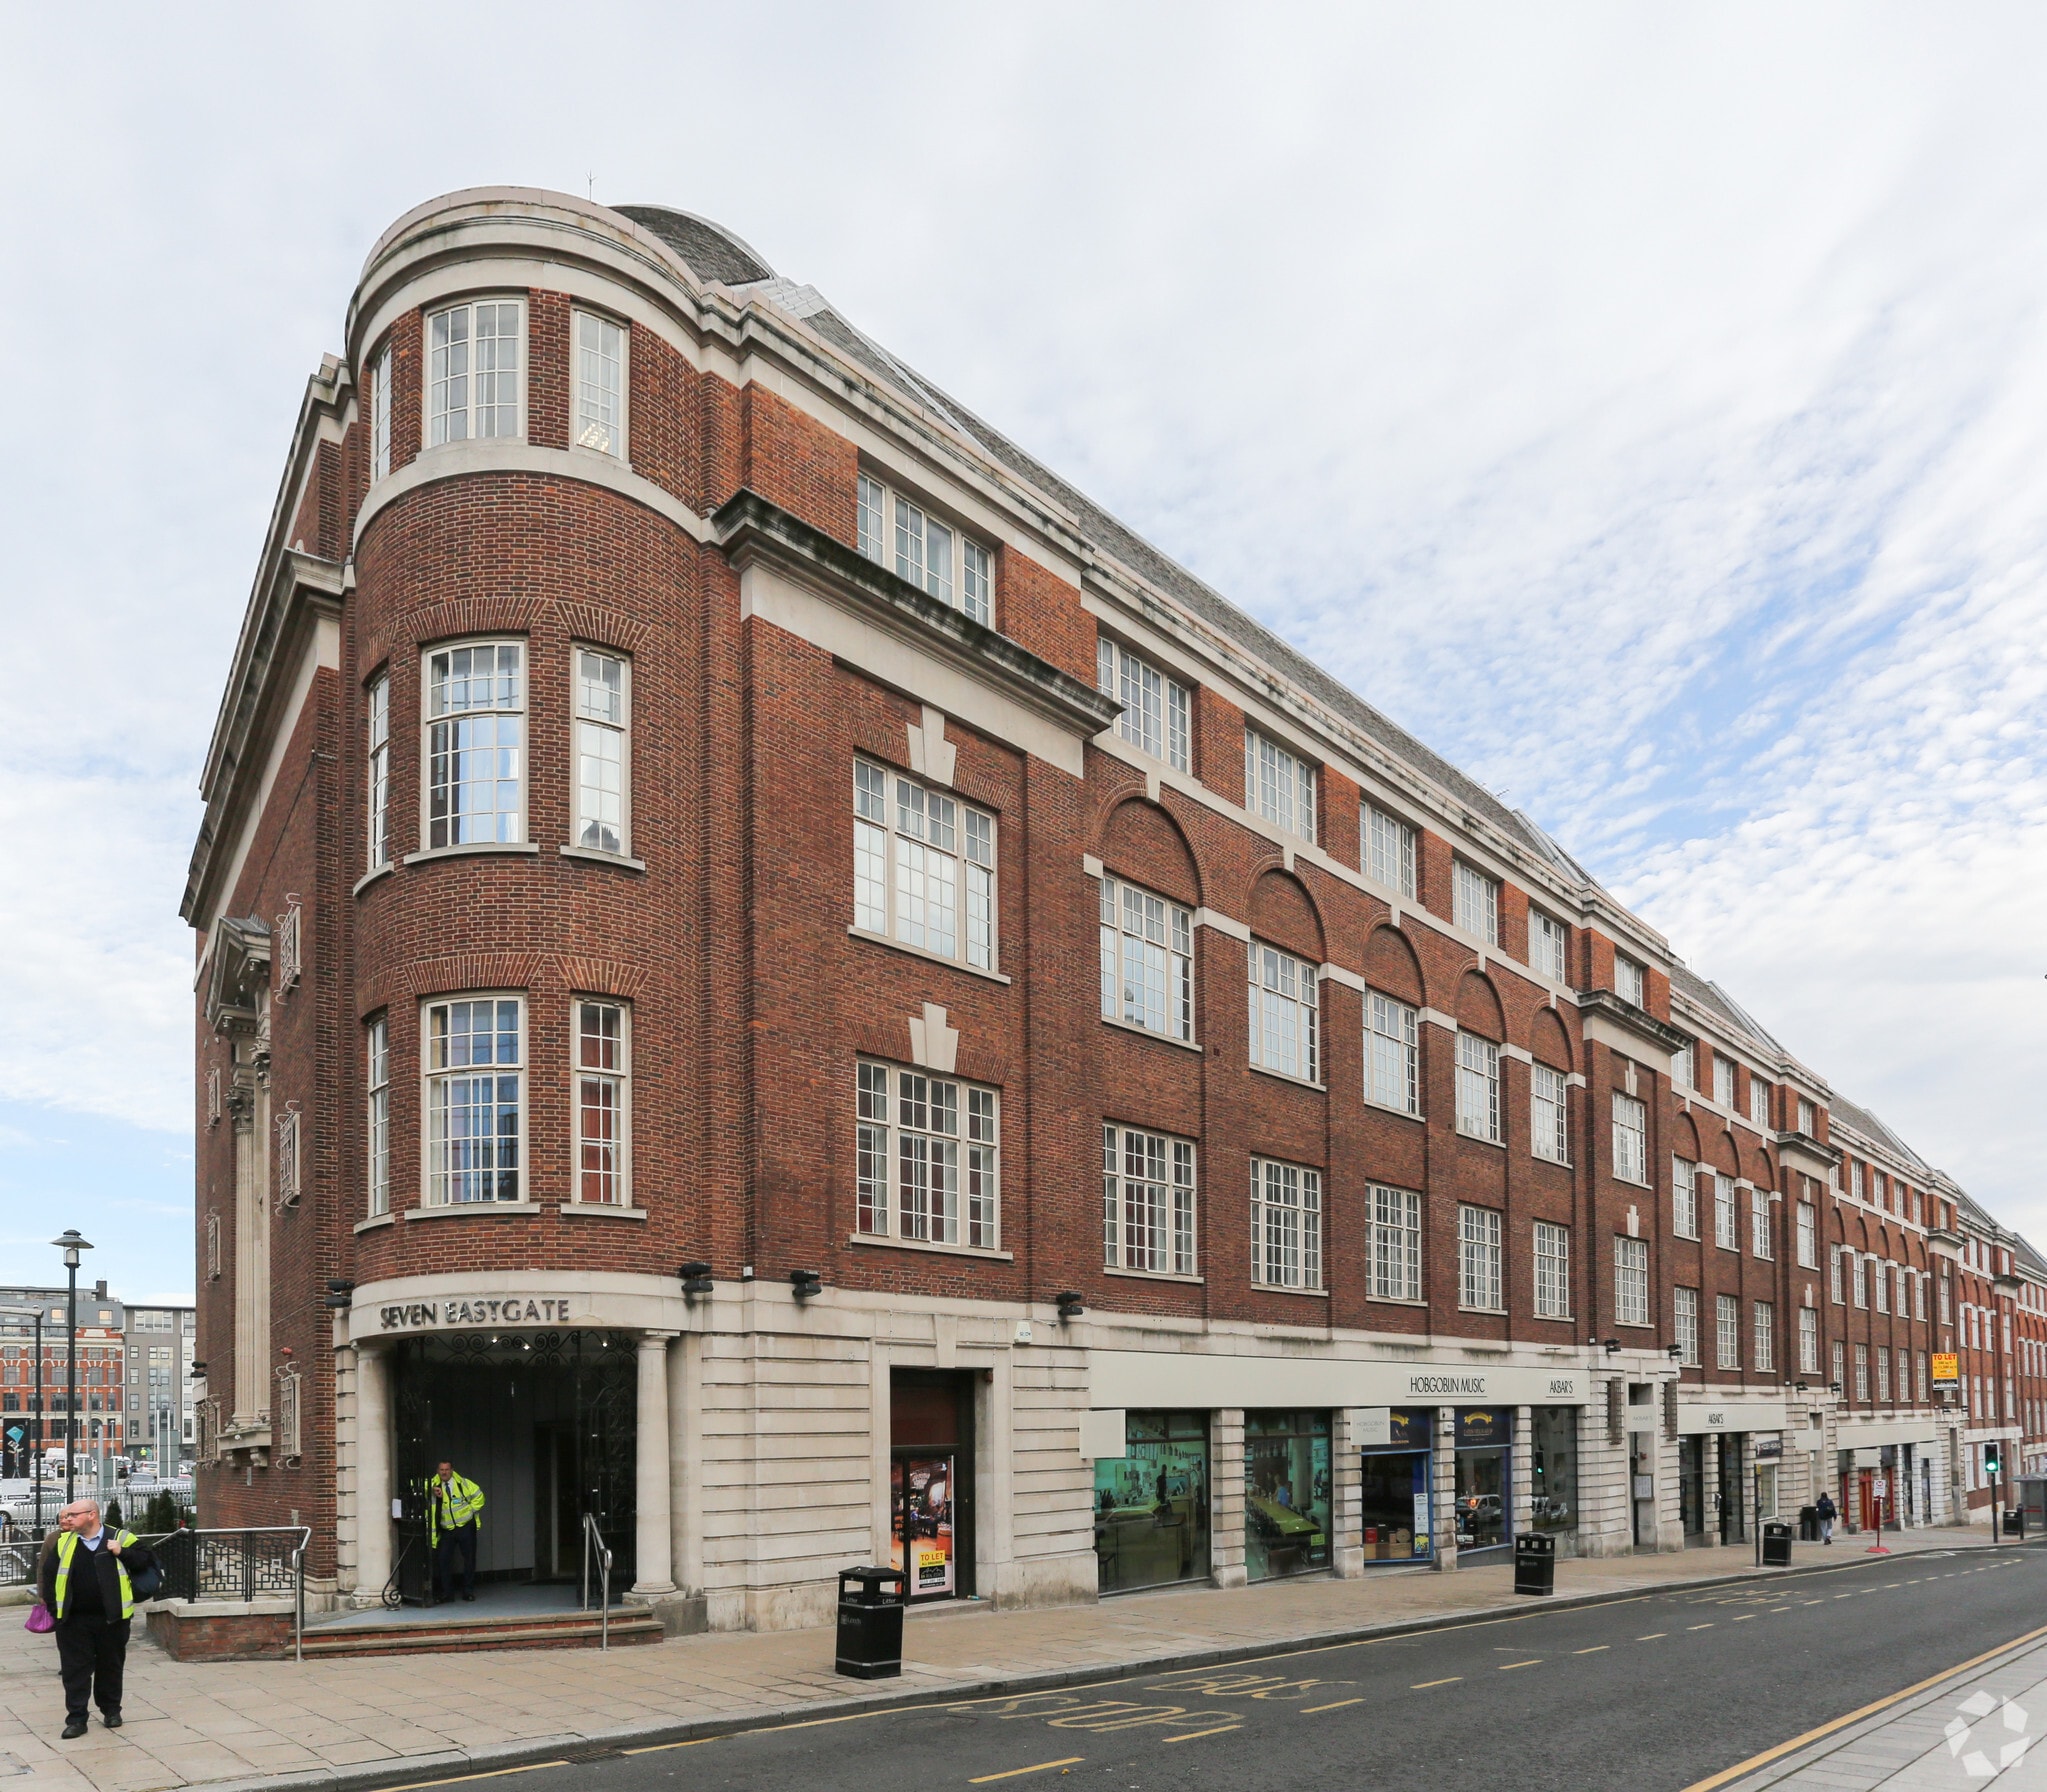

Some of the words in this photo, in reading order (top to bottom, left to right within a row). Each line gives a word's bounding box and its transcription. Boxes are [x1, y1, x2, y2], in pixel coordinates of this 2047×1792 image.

[380, 1302, 438, 1328] SEVEN
[444, 1299, 570, 1324] EASTGATE
[1410, 1376, 1459, 1393] HOBGOBLIN
[1460, 1378, 1486, 1393] MUSIC
[1549, 1380, 1574, 1394] AKBAR'S
[931, 1552, 944, 1560] LET
[1143, 1673, 1358, 1700] BUS
[946, 1697, 1246, 1733] STOP
